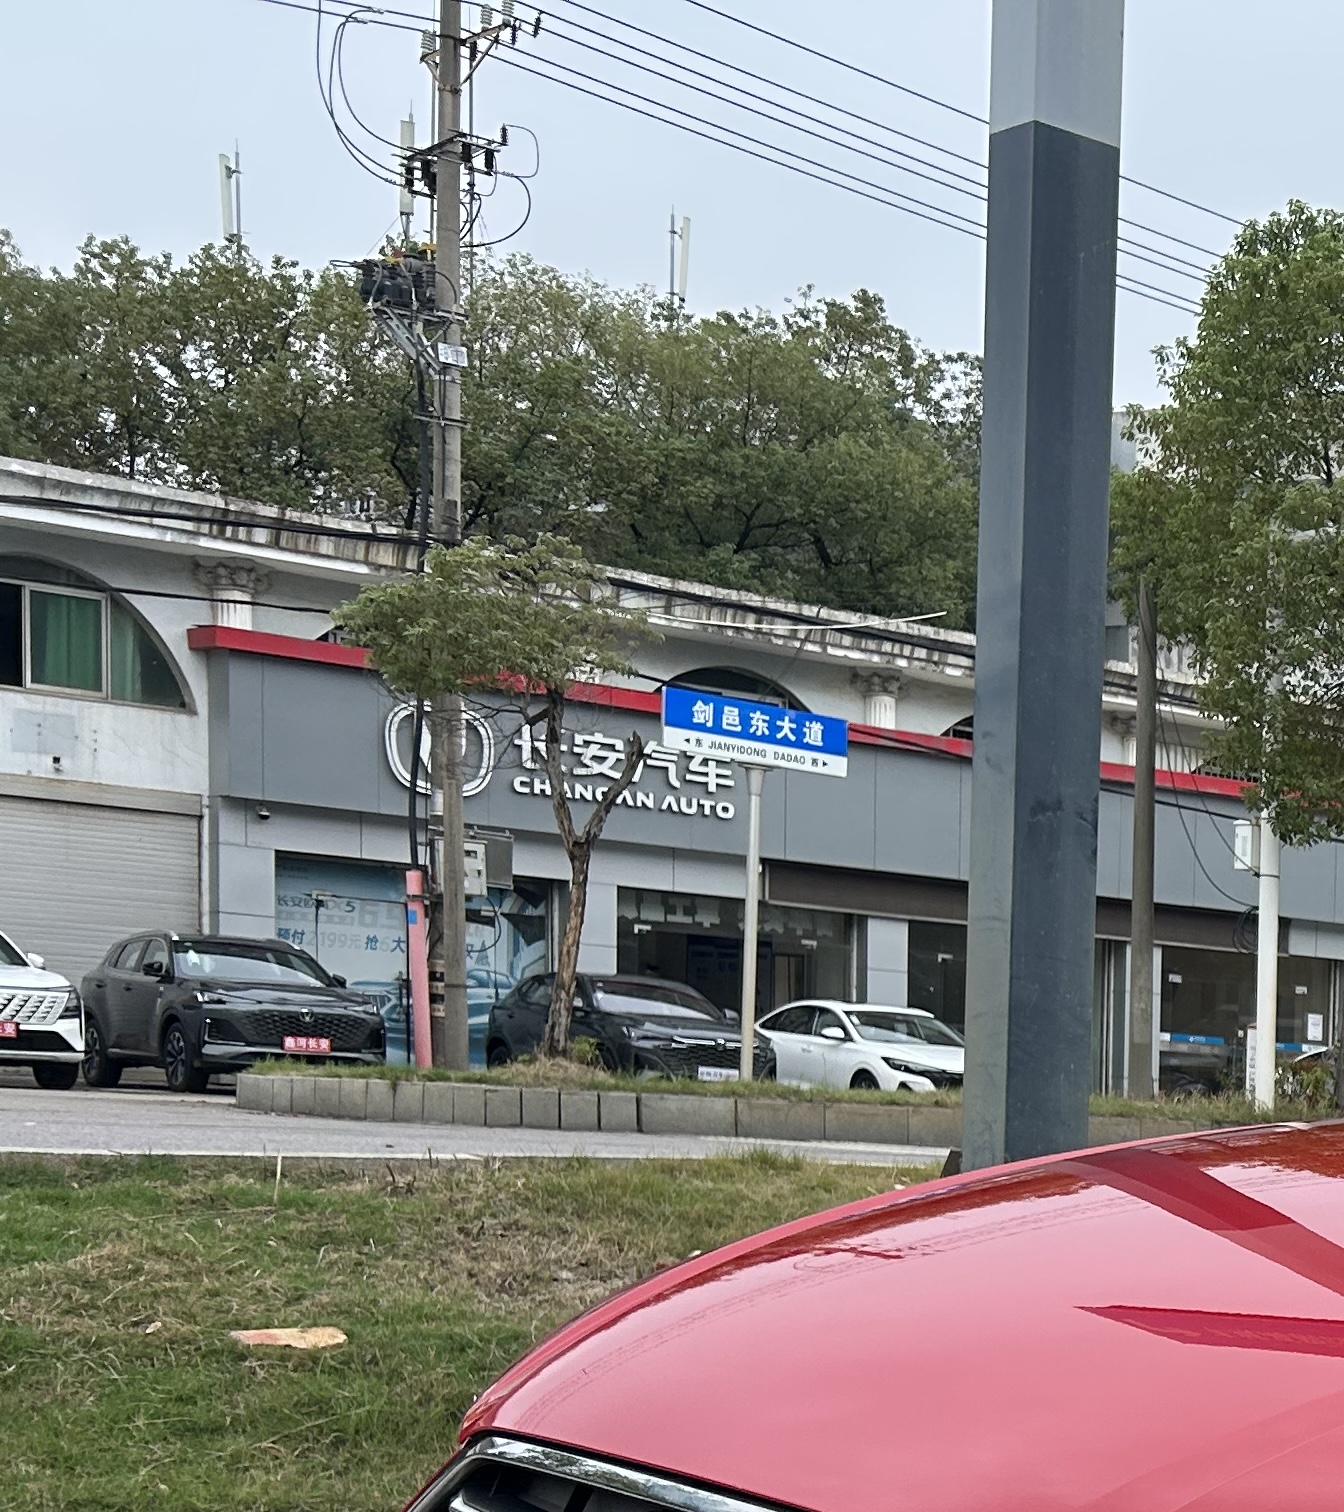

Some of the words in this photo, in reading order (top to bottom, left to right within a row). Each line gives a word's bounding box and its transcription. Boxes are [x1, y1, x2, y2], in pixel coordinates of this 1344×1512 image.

[692, 699, 824, 746] 剑邑东大道
[513, 723, 735, 793] 长安汽车
[708, 740, 767, 759] JIANYIDONG
[773, 751, 806, 765] DADAO
[661, 794, 735, 819] AUTO
